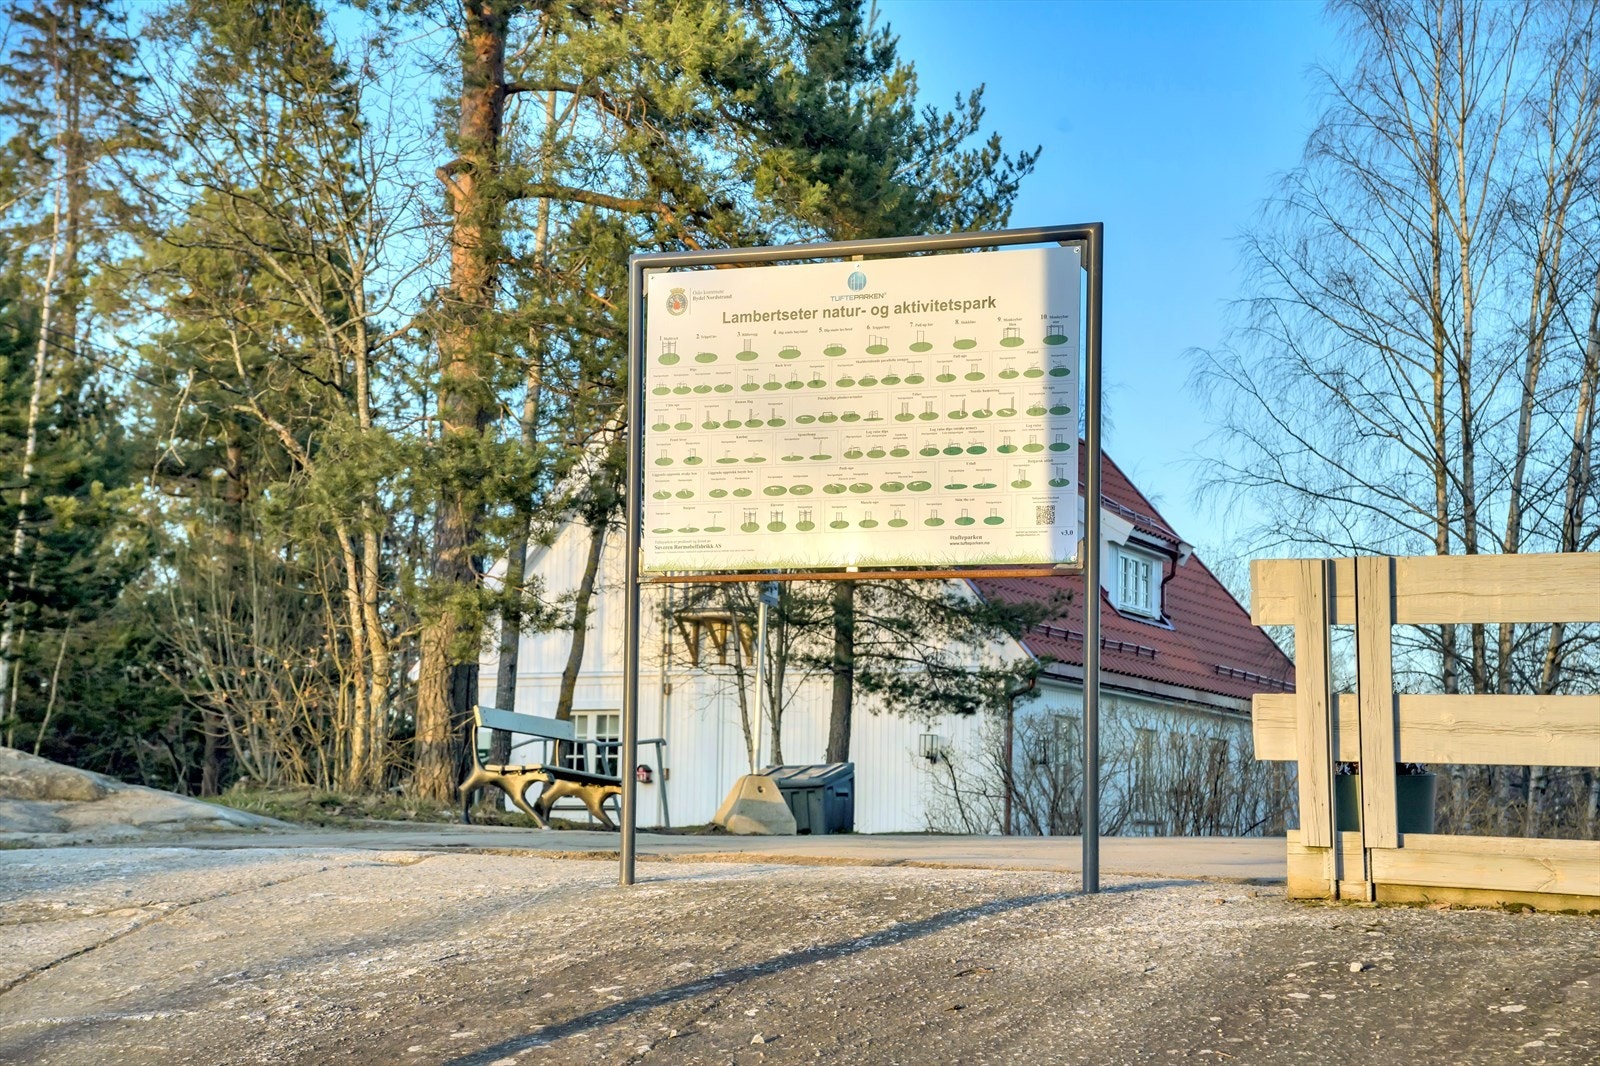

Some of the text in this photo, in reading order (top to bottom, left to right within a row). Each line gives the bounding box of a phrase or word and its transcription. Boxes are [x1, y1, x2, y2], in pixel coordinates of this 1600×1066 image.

[722, 296, 996, 324] Lambertseter natur- og aktivitetspark
